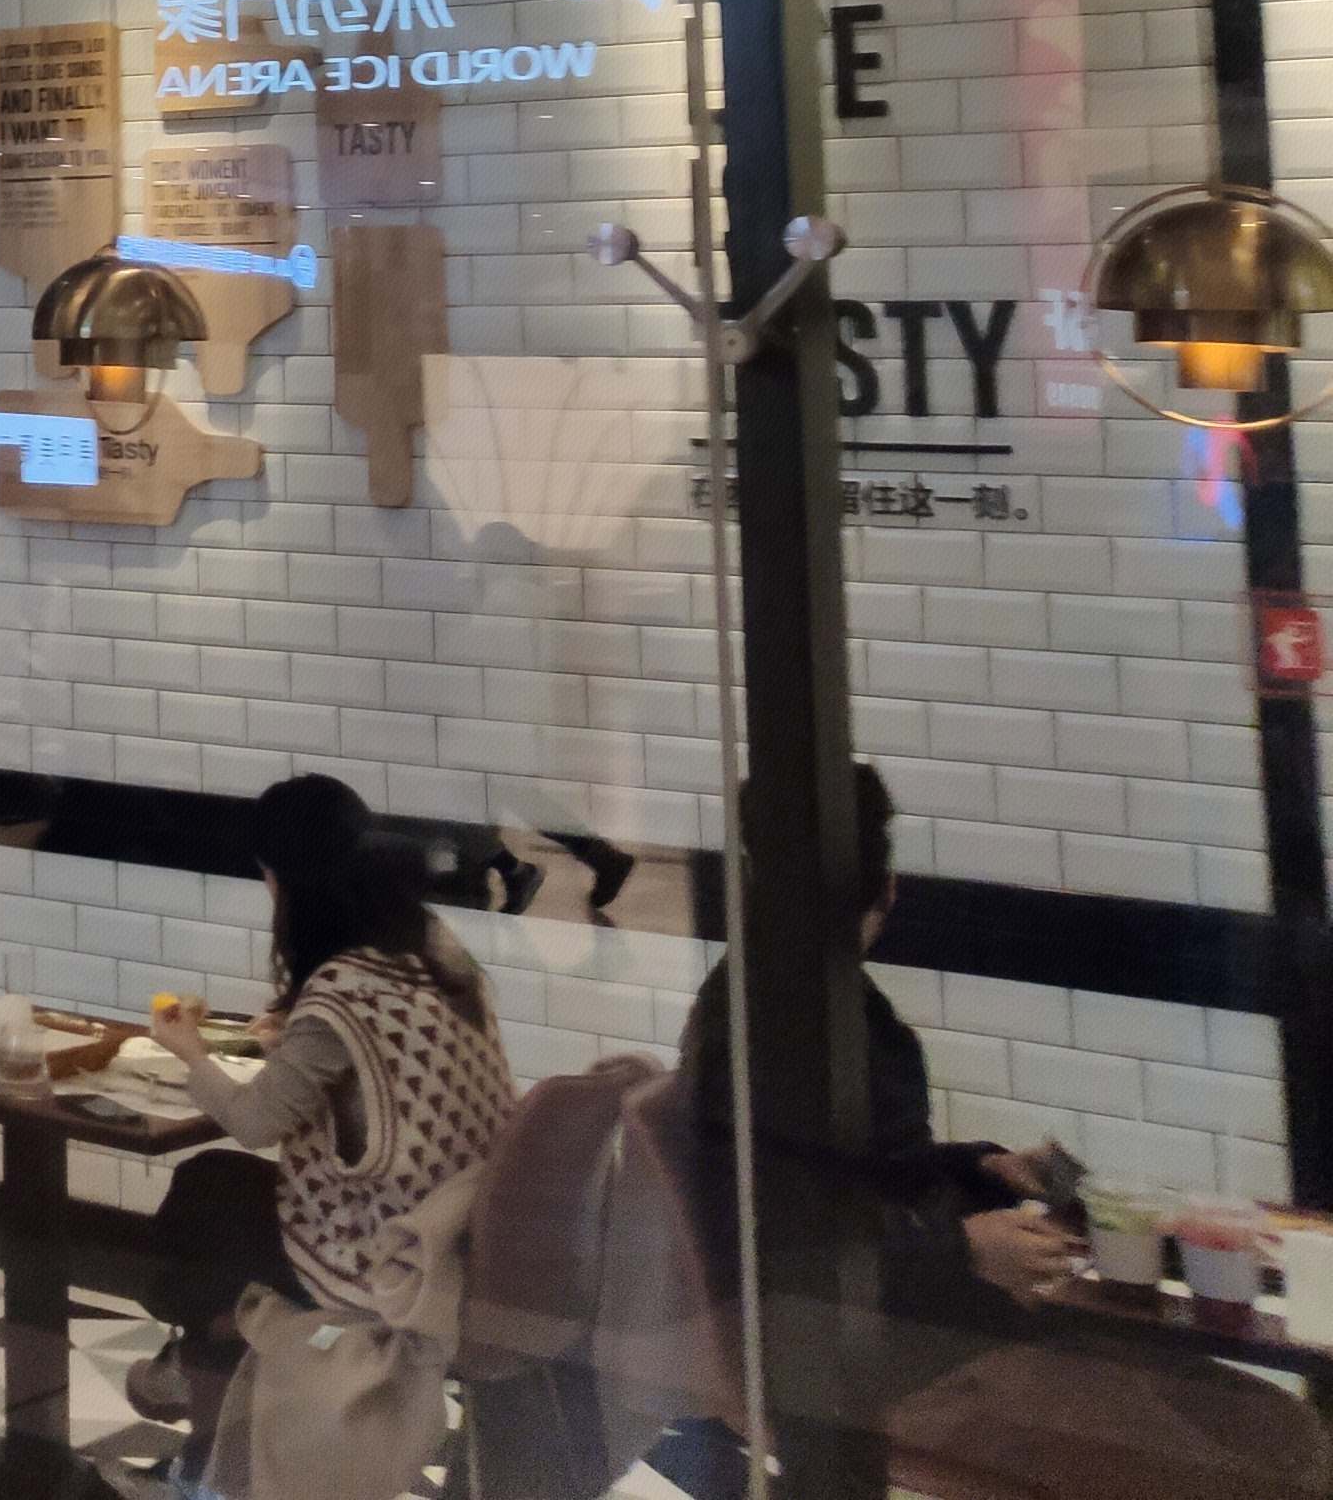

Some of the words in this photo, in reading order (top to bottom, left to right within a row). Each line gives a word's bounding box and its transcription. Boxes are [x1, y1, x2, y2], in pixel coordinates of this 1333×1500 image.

[1, 88, 32, 113] AND
[334, 121, 416, 156] TASTY
[835, 298, 1017, 419] STY
